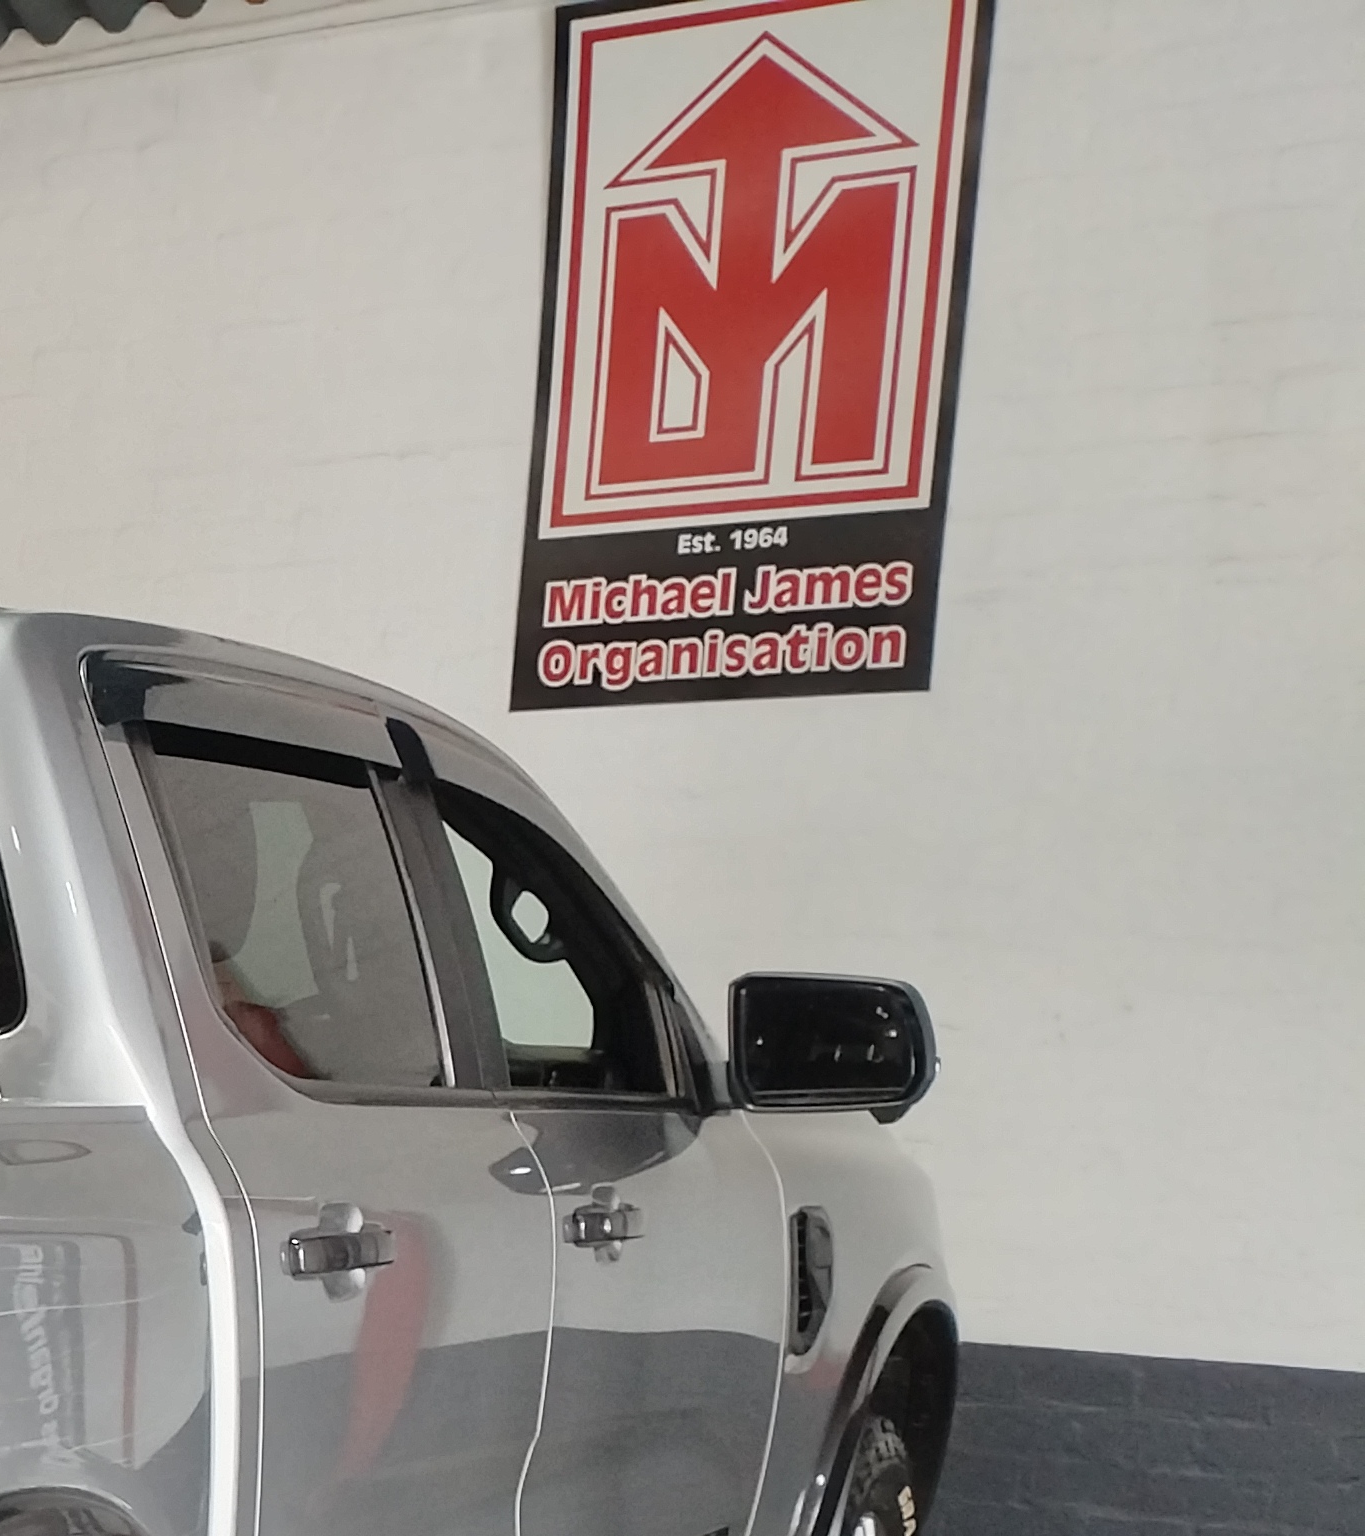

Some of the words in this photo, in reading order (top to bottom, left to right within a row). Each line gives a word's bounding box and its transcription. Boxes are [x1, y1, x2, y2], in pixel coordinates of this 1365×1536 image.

[677, 531, 721, 555] Est.
[730, 526, 788, 551] 1964
[542, 567, 737, 628] Michael
[744, 560, 914, 615] James
[537, 622, 907, 691] Organisation
